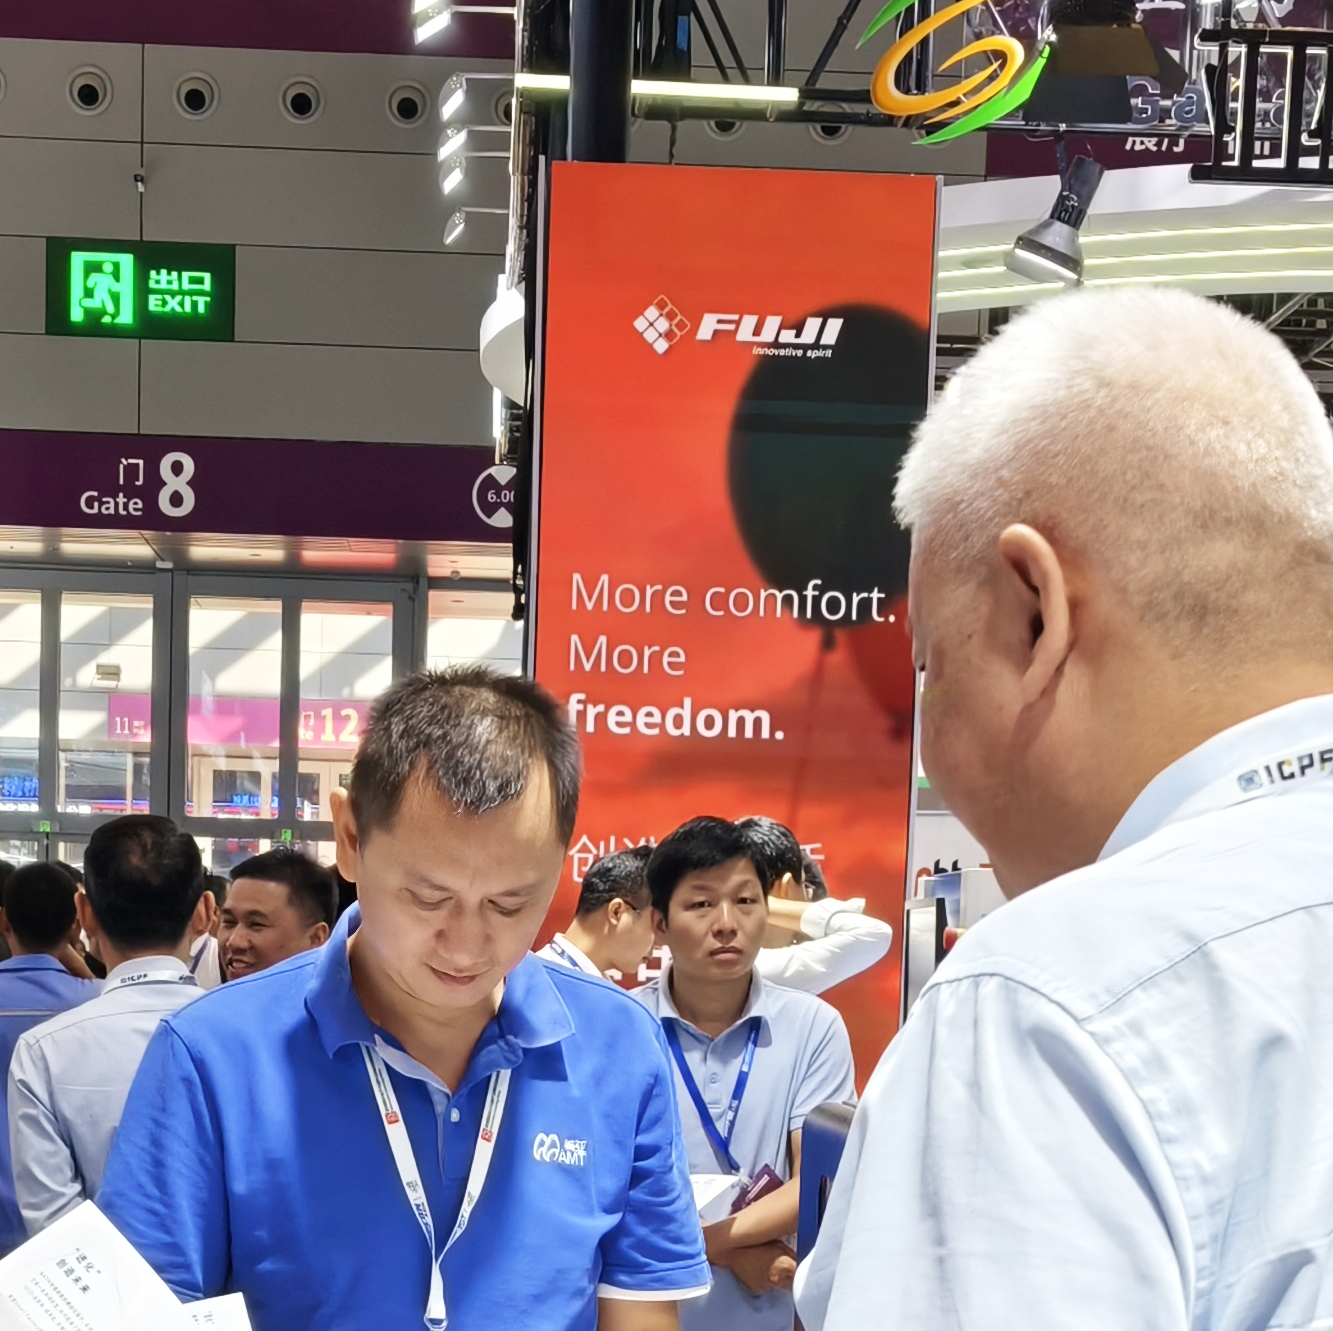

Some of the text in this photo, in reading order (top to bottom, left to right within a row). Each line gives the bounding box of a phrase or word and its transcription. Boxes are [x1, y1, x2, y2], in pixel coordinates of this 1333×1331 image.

[148, 269, 211, 291] 出口
[148, 294, 211, 313] EXIT
[696, 313, 844, 345] FUJI
[80, 451, 196, 517] Gate 8
[119, 457, 144, 486] 门
[570, 572, 897, 624] More comfort.
[569, 633, 686, 676] More
[115, 716, 130, 734] 11
[321, 707, 359, 742] 12
[567, 693, 786, 741] freedom.
